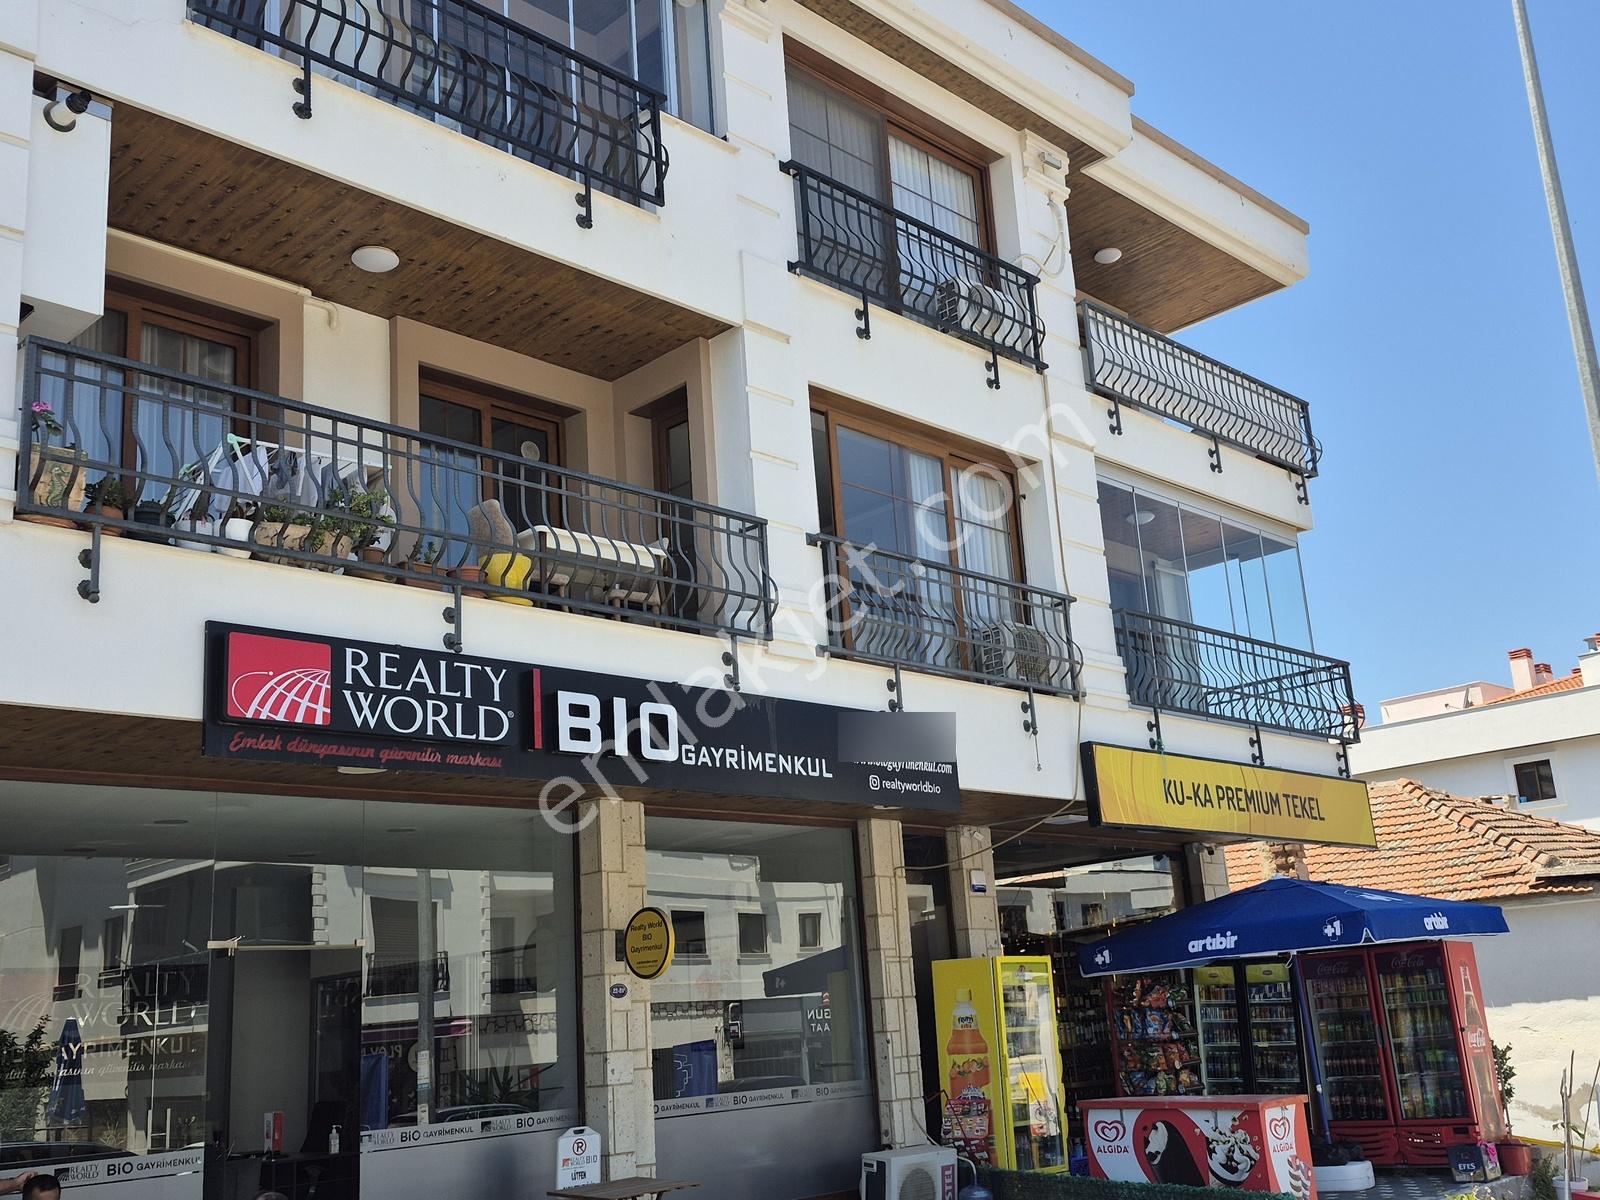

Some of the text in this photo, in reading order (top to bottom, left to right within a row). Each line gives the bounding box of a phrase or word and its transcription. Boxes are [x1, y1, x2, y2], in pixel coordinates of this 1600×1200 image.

[344, 646, 508, 702] REALTY
[341, 689, 510, 741] WORLD
[557, 690, 679, 762] BIO
[228, 731, 502, 768] Emlak dünyasının güvenilir markası
[681, 744, 833, 778] GAYRİMENKUL
[882, 778, 941, 794] realtyworldbio
[1163, 778, 1326, 821] KU-KA PREMIUM TEKEL
[74, 970, 195, 999] REALTY
[71, 1000, 197, 1029] WORLD
[1096, 1144, 1129, 1154] ALGIDA
[1273, 1142, 1294, 1153] ALGIDA
[1458, 1162, 1476, 1171] EFES
